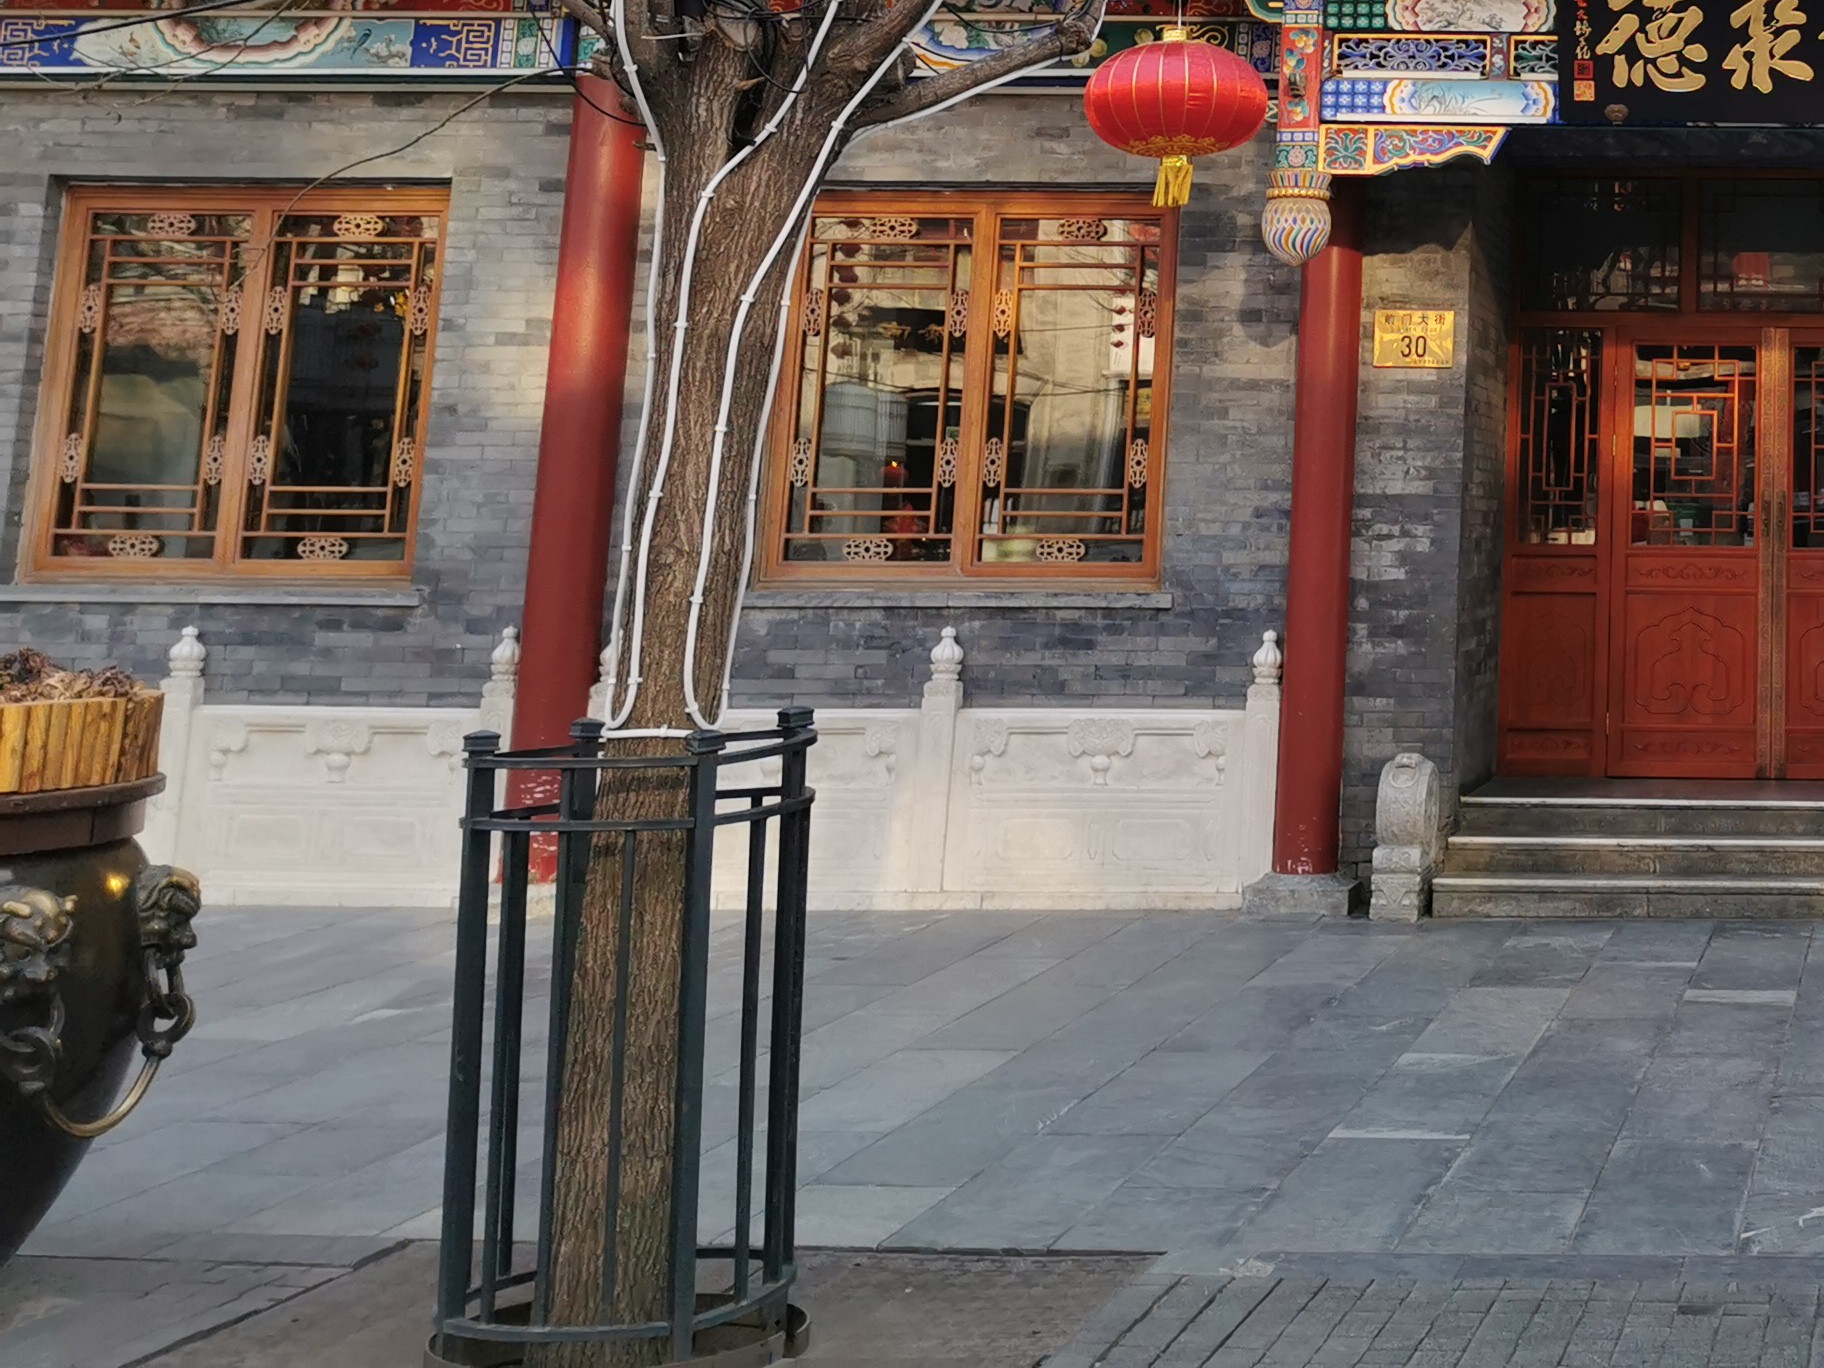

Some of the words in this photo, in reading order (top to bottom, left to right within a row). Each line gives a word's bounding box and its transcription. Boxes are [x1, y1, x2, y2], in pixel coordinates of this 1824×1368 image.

[1384, 313, 1446, 326] 前门大街
[1400, 335, 1427, 358] 30
